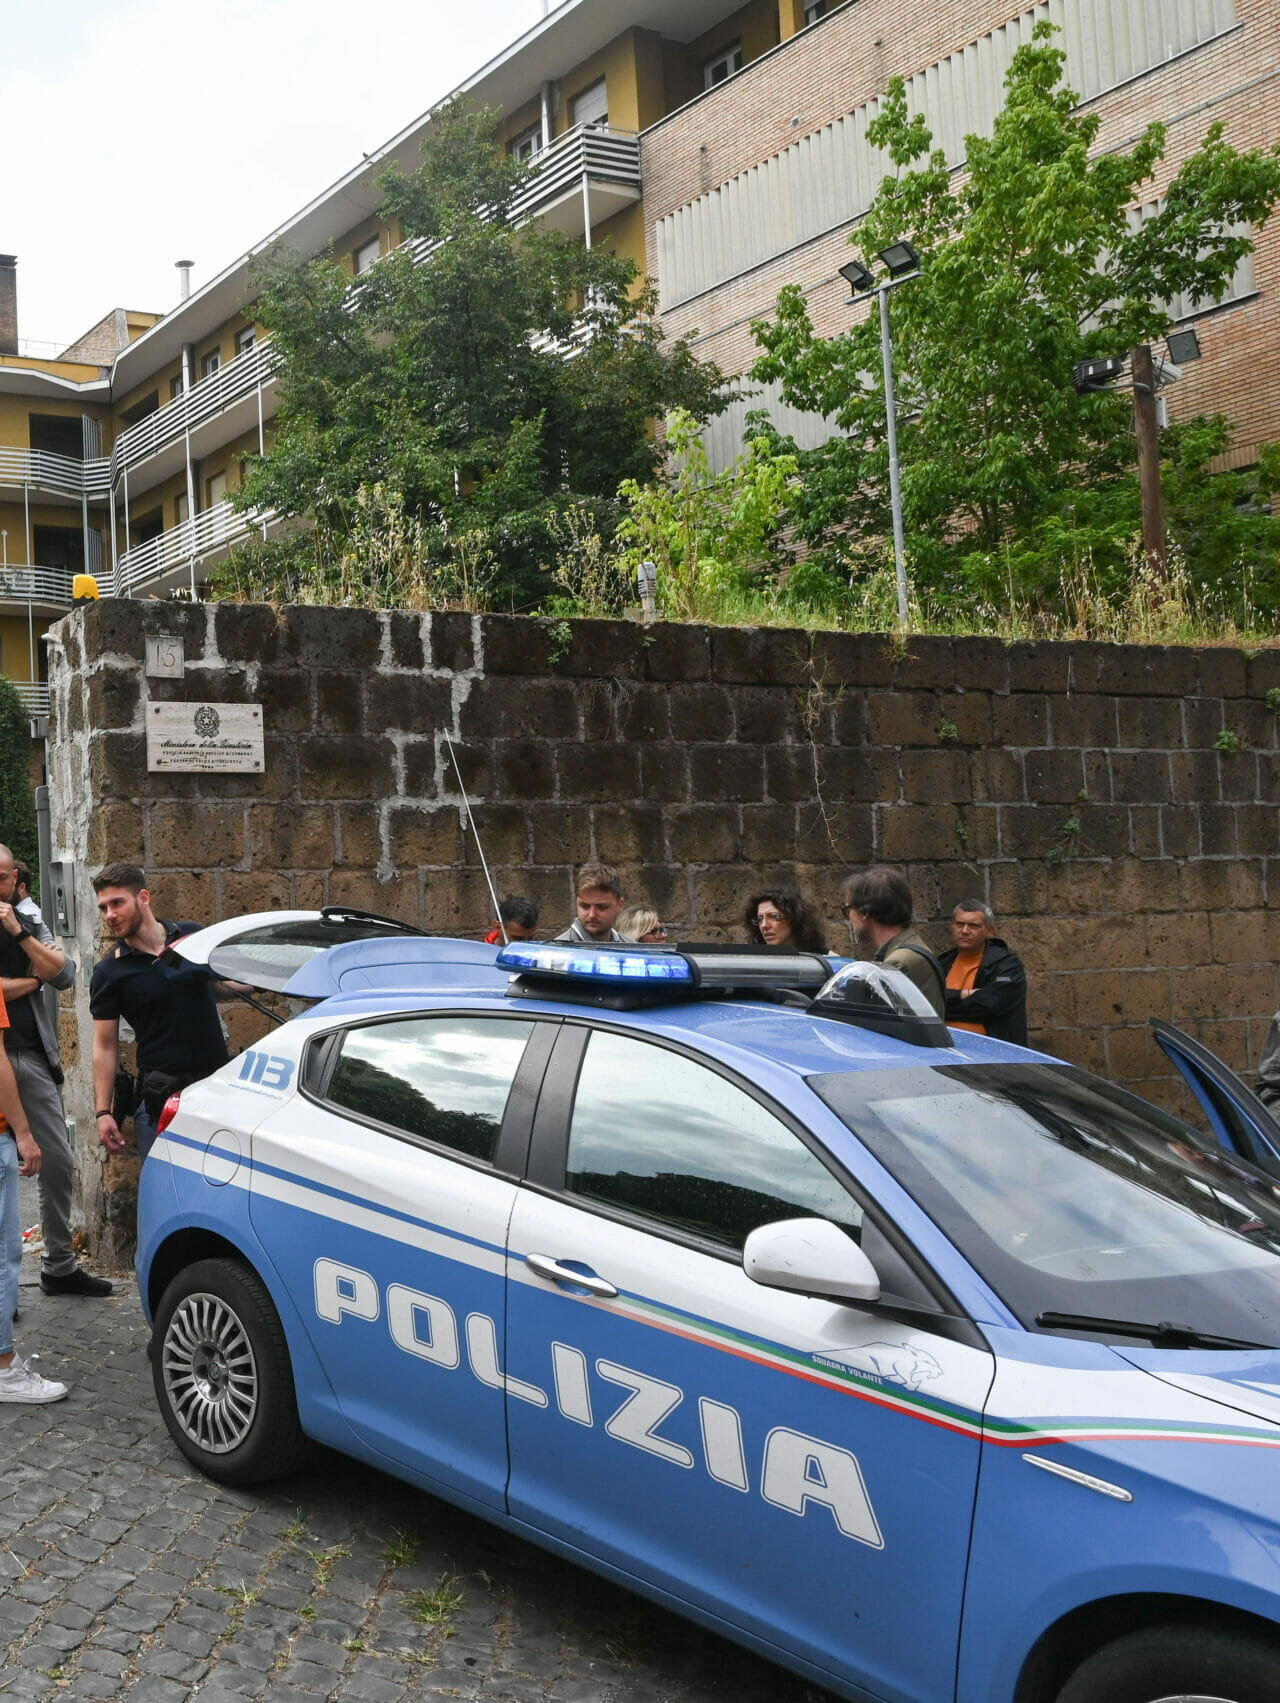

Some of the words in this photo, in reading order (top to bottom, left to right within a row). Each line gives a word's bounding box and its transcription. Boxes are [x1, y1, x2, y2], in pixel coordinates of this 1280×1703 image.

[156, 644, 176, 668] 15
[199, 740, 217, 748] della
[238, 1050, 296, 1091] 113
[812, 1355, 848, 1374] SQUADRA
[848, 1366, 883, 1385] VOLANTE
[313, 1256, 885, 1549] POLIZIA
